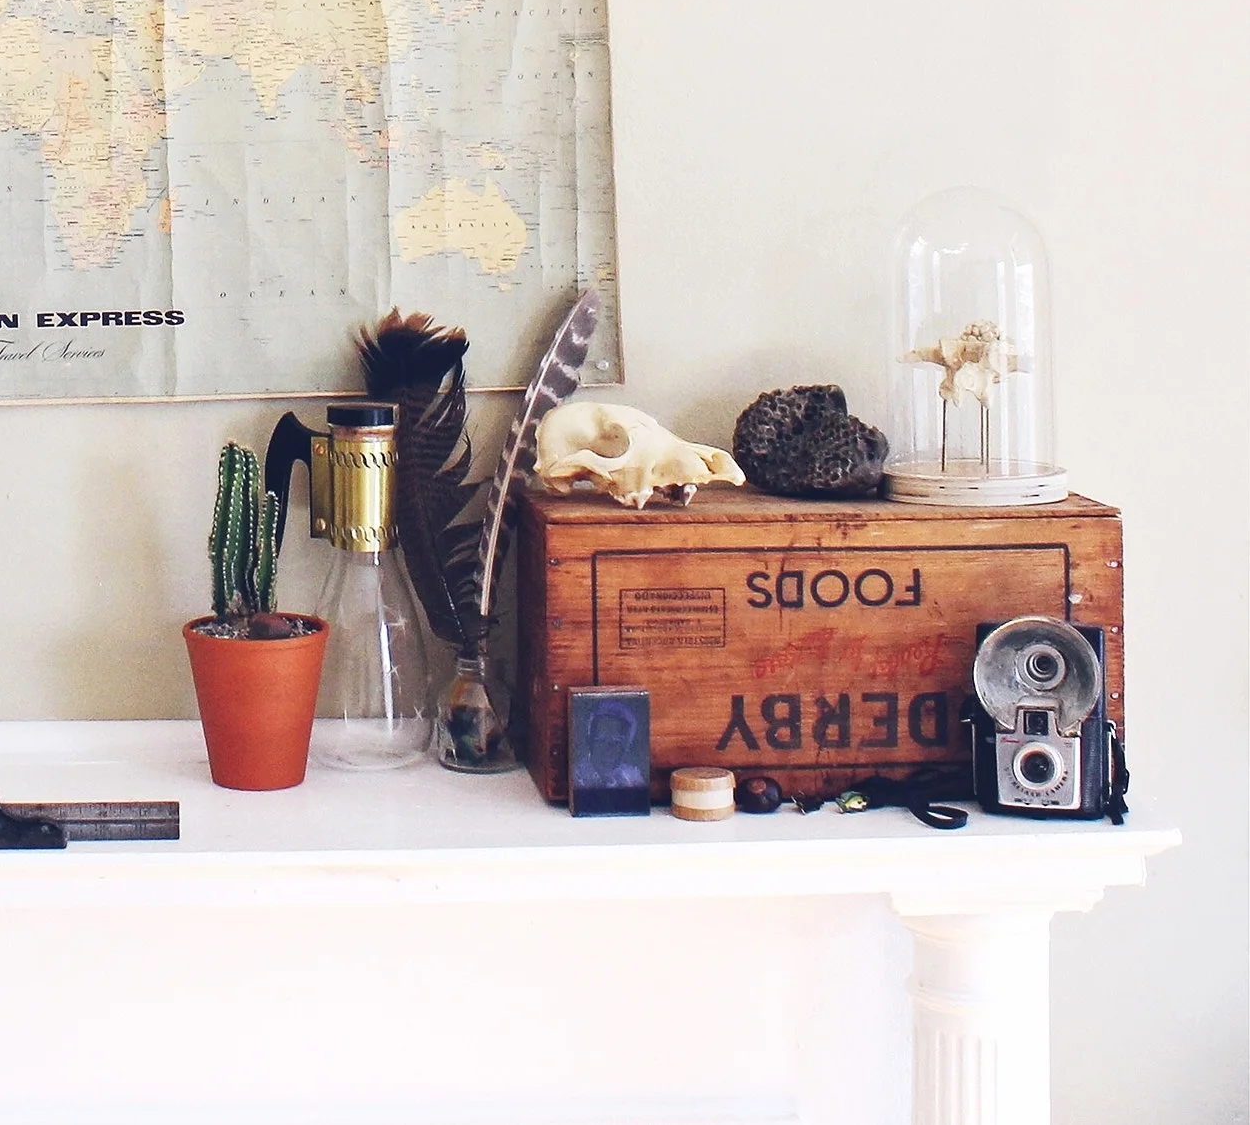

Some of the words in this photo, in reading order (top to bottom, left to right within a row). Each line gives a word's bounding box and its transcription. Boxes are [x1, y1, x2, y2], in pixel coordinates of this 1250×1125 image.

[205, 195, 359, 206] INDIAN
[220, 288, 346, 299] OCEAN
[36, 309, 186, 329] EXPRESS
[40, 339, 106, 362] Services
[746, 568, 922, 609] FOODS
[715, 691, 947, 752] DERBY
